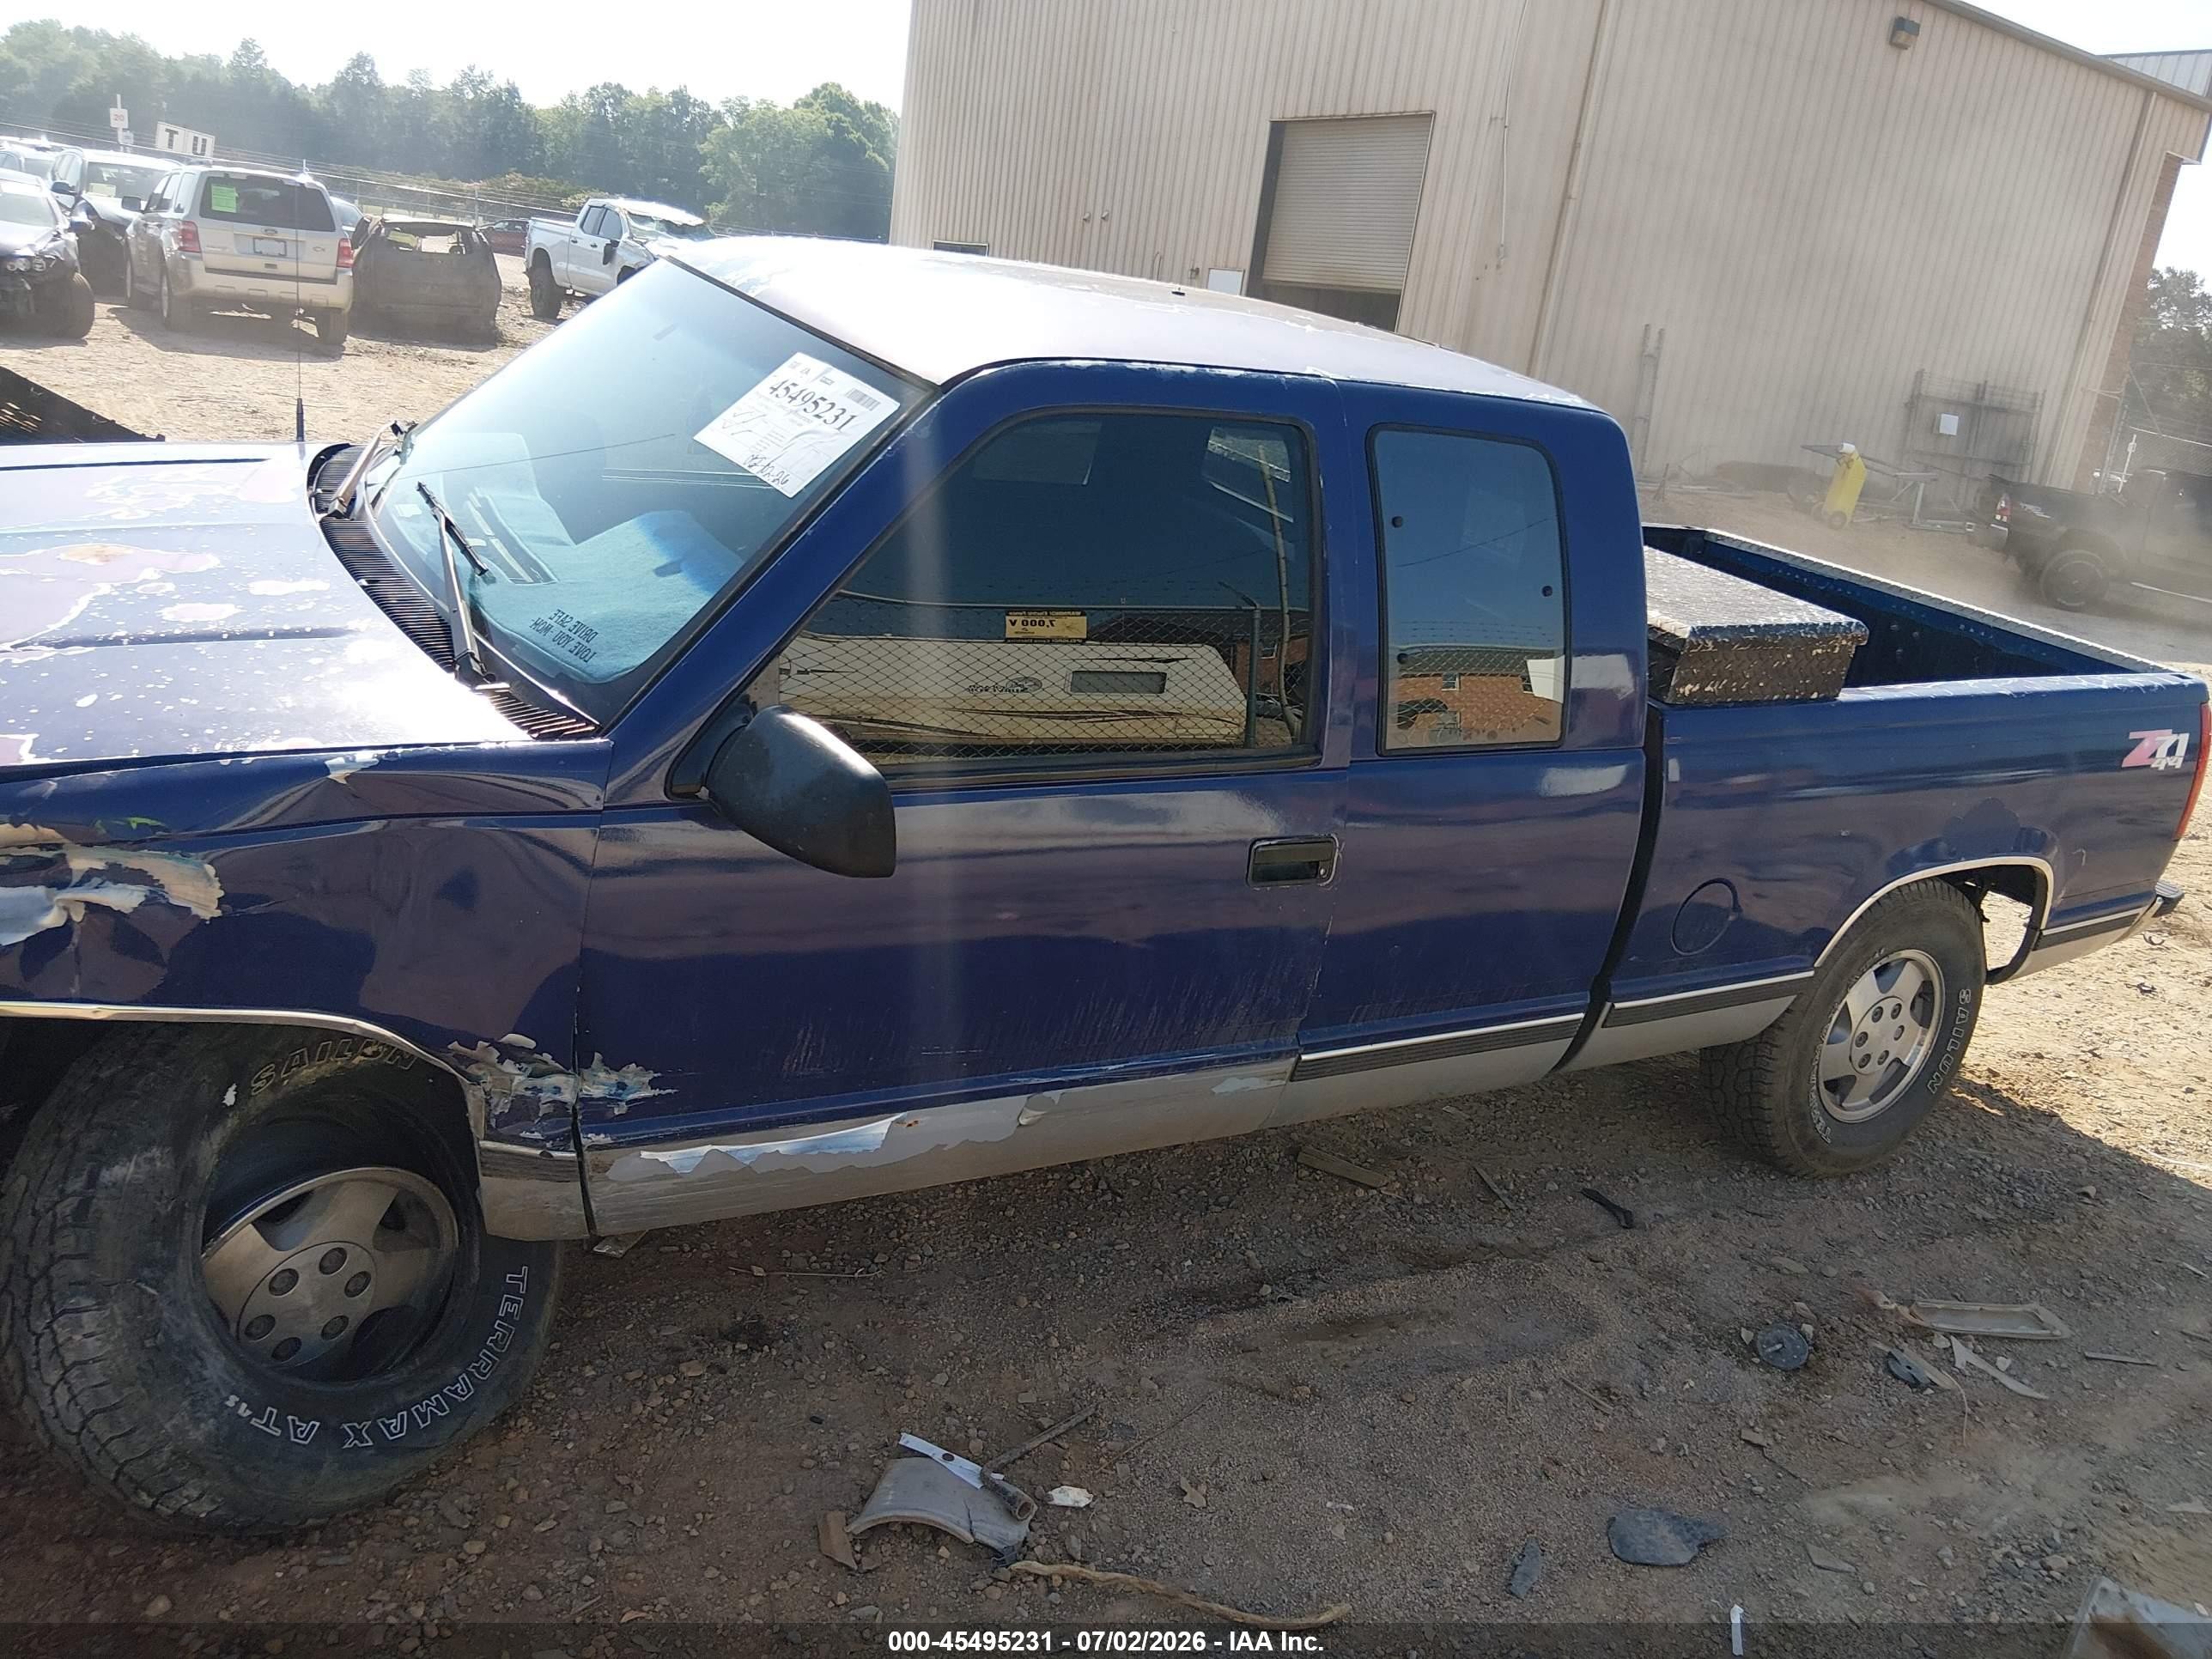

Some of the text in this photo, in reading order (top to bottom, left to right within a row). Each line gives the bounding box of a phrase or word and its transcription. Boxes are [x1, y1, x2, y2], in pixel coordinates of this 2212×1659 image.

[164, 127, 207, 156] T U
[769, 378, 859, 433] 45495231
[2121, 728, 2191, 769] Z71
[1926, 988, 1972, 1095] SAILUN
[340, 1265, 530, 1449] TERRAMAX
